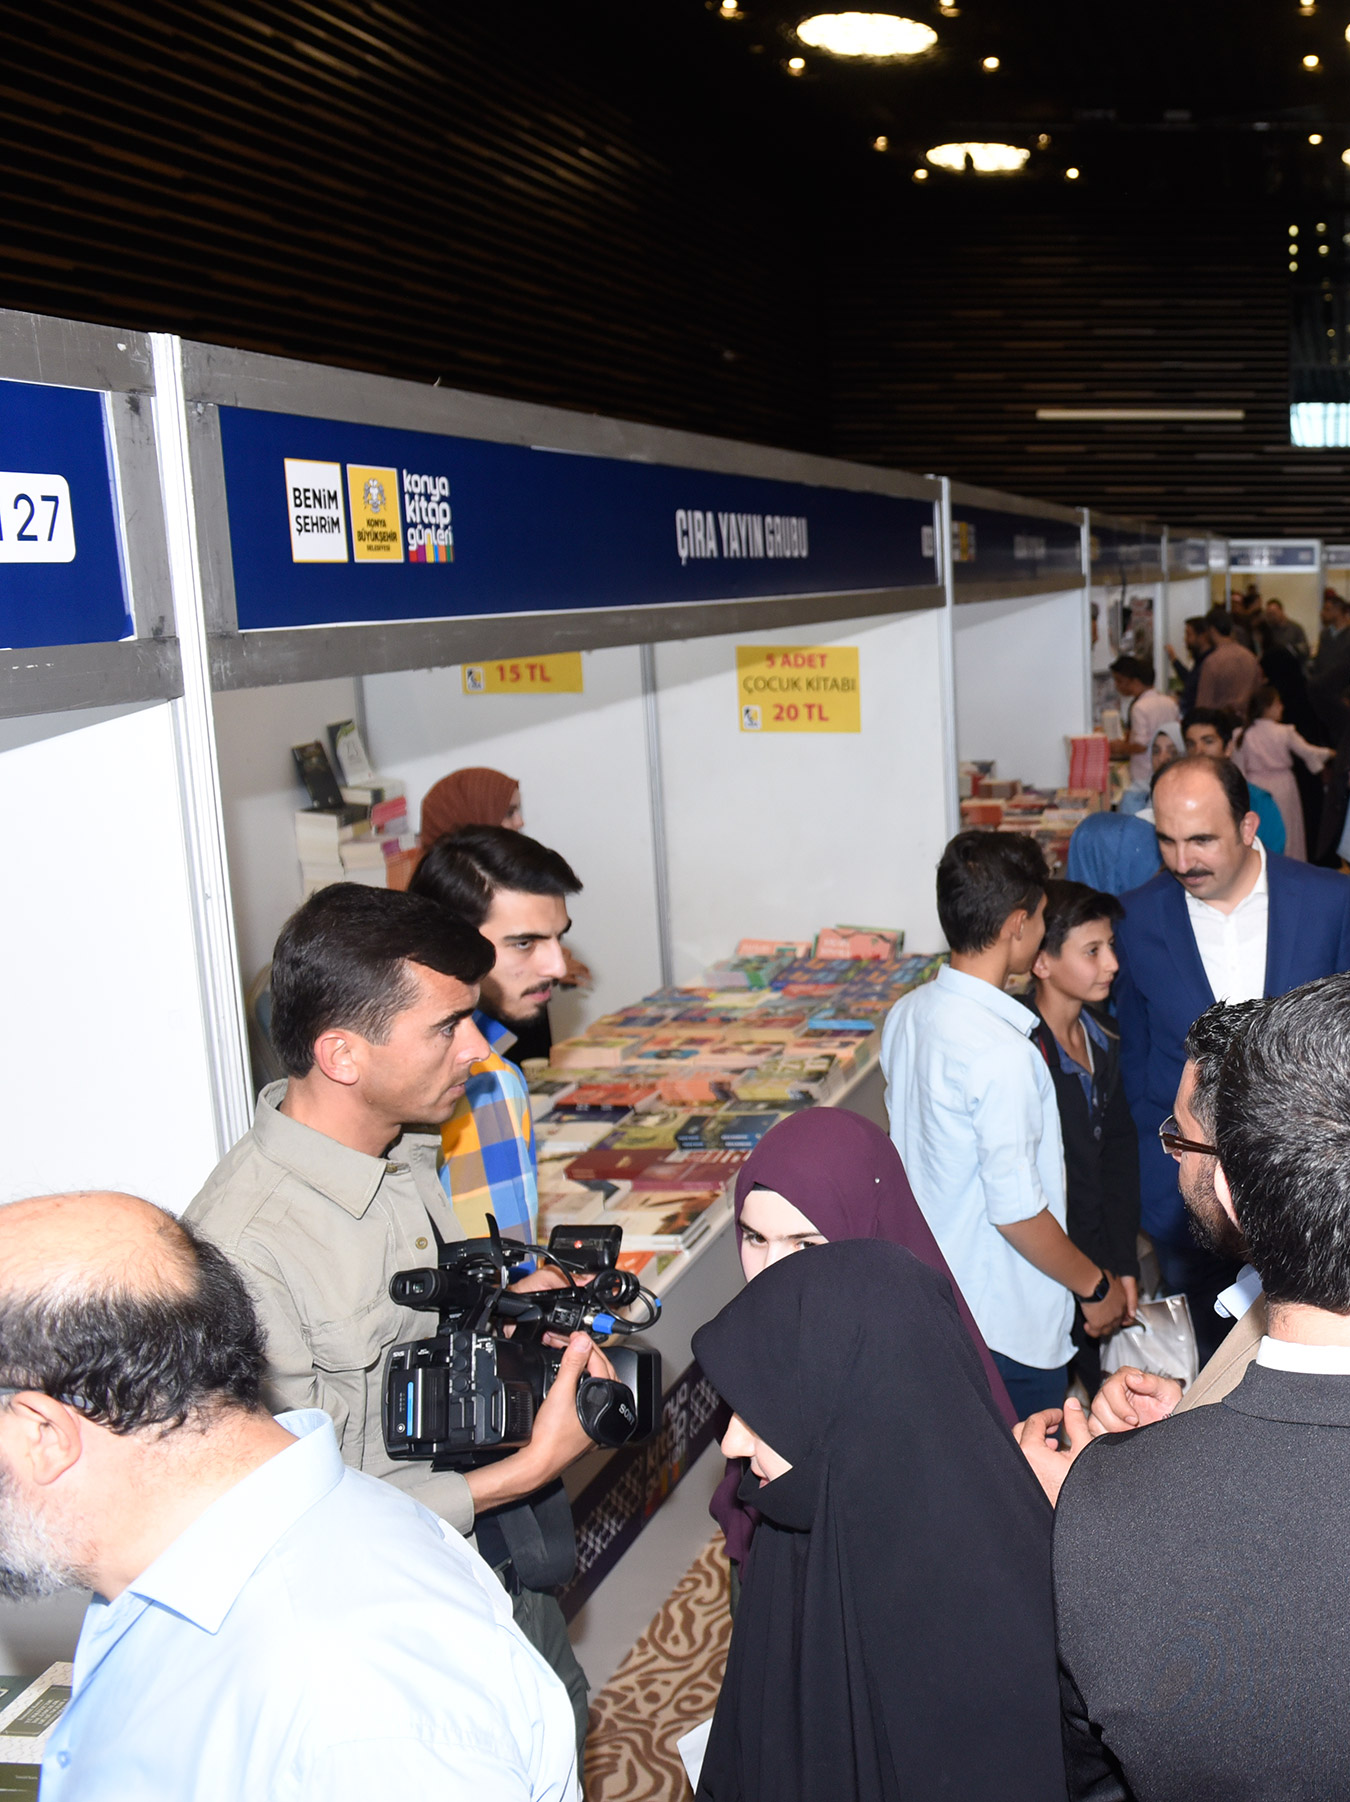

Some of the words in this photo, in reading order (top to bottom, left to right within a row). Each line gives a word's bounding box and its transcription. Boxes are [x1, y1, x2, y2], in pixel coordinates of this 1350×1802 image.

[402, 468, 450, 500] konya
[0, 493, 59, 541] 27
[404, 493, 451, 527] kitap
[407, 523, 453, 551] günleri
[675, 508, 718, 566] ÇIRA
[718, 512, 764, 559] YAYIN
[764, 514, 809, 559] GRUBU
[497, 664, 521, 682] 15
[526, 663, 551, 682] TL
[766, 653, 776, 669] 5
[780, 653, 828, 669] ADET
[743, 675, 801, 694] ÇOCUK
[805, 674, 856, 692] KİTABI
[773, 703, 799, 722] 20
[803, 703, 829, 722] TL
